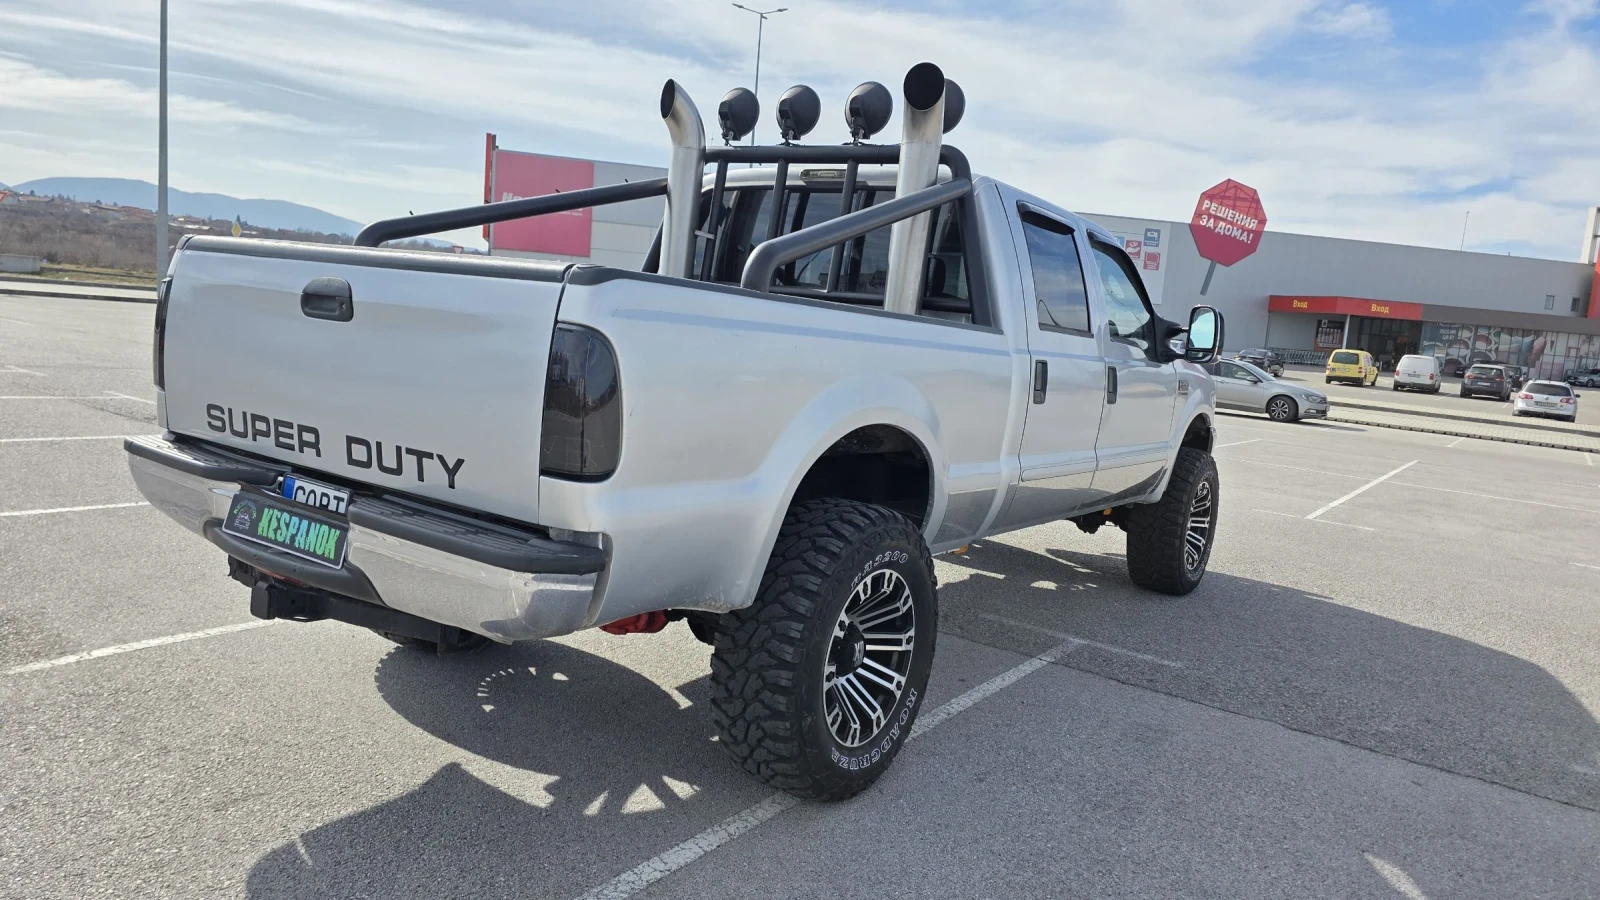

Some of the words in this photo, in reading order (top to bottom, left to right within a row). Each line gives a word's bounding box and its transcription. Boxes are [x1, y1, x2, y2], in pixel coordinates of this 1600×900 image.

[1200, 215, 1214, 229] ЗА
[1215, 221, 1253, 244] ДОМА!
[1202, 200, 1258, 230] РЕШЕНИЯ
[1293, 300, 1308, 309] Вход
[1371, 304, 1389, 314] Вход
[206, 403, 321, 458] SUPER
[345, 434, 465, 490] DUTY
[257, 507, 340, 560] KESPANOK
